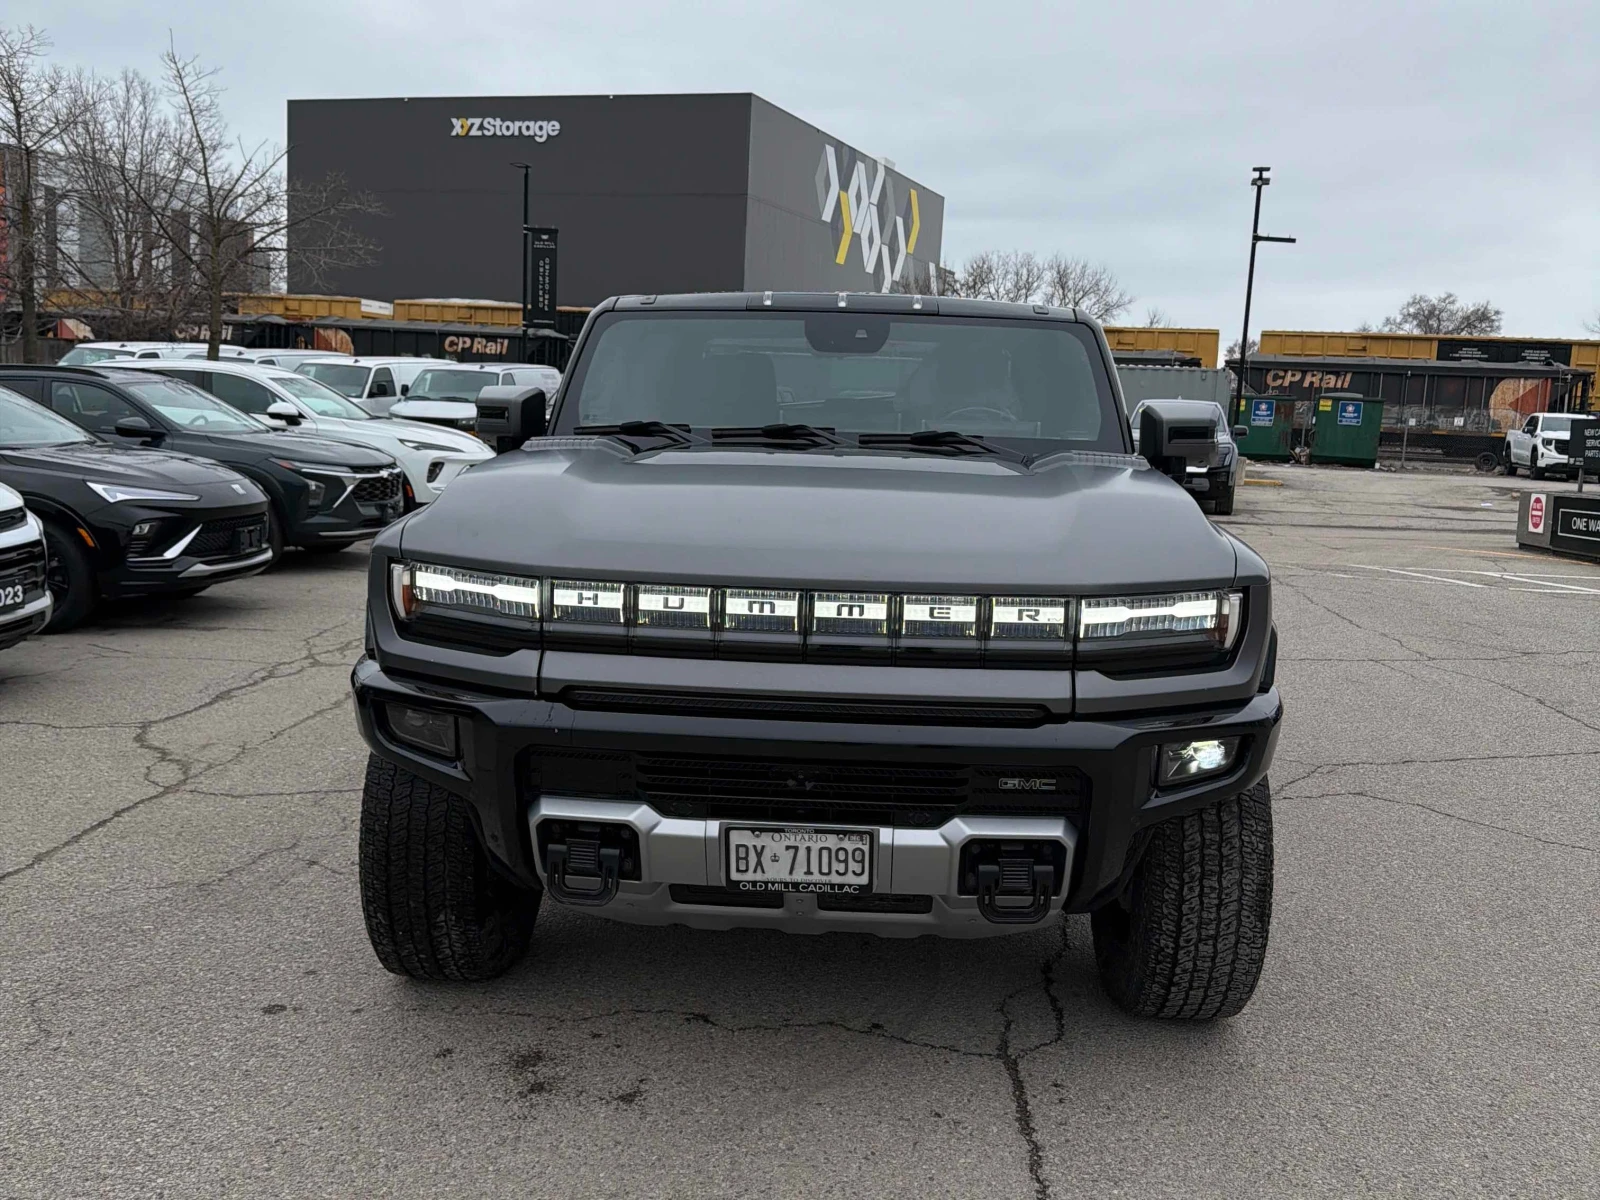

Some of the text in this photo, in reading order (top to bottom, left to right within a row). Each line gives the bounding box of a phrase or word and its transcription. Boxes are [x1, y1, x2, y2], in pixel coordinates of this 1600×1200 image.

[444, 335, 509, 355] CP Rail
[1266, 369, 1353, 389] CP Rail
[1584, 449, 1599, 458] PARTS
[1571, 516, 1588, 531] ONE
[998, 777, 1057, 791] GMC
[771, 832, 828, 844] ONTARIO
[735, 843, 866, 876] BX 71099
[739, 881, 860, 894] OLD MILL CADILLAC
